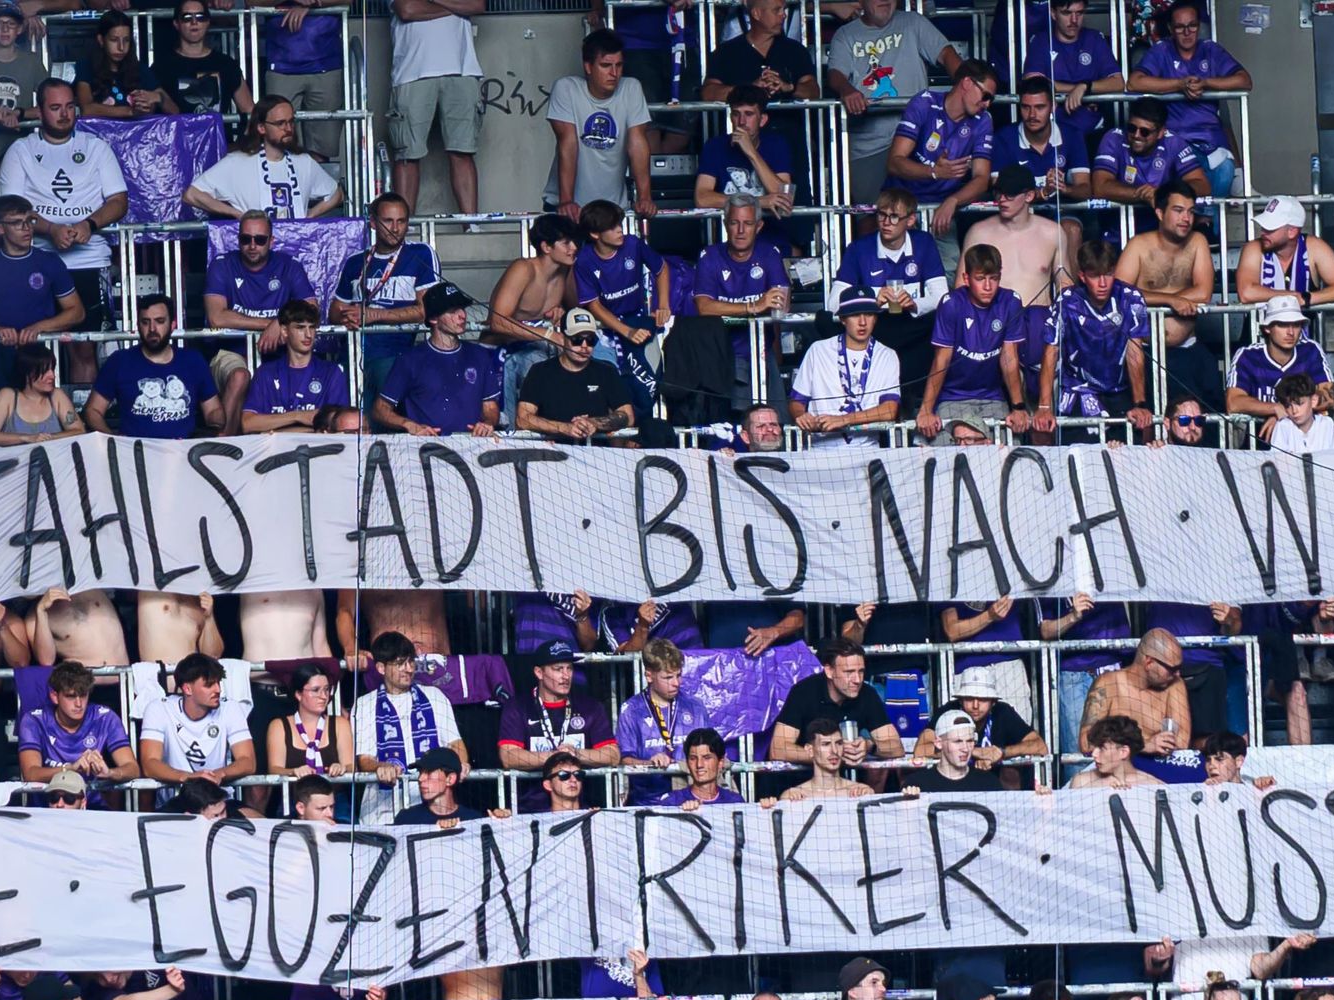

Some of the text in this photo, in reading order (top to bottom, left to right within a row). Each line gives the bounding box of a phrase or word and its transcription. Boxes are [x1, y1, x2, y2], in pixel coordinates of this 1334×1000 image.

[853, 33, 903, 57] GOOFY
[35, 204, 94, 219] STEELCOIN
[634, 453, 808, 597] BIS
[867, 446, 1147, 602] NACH
[130, 793, 1030, 985] EGOZENTRIKER
